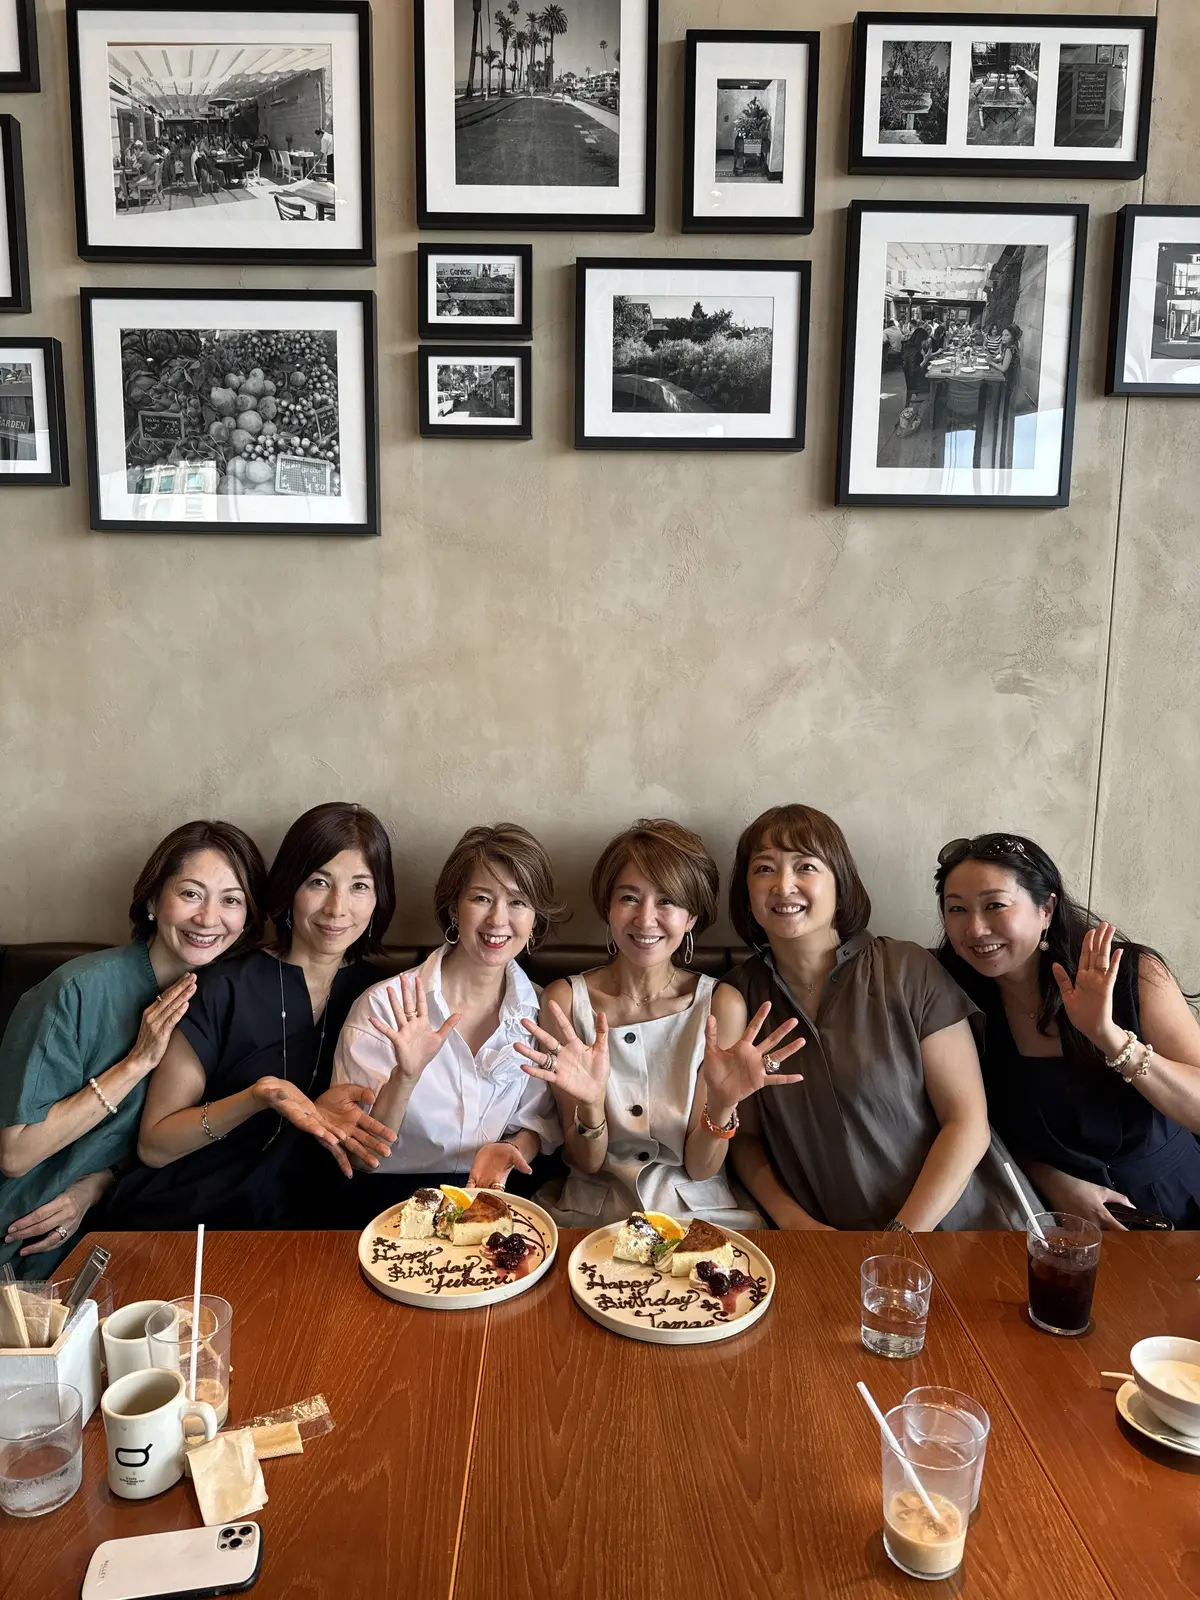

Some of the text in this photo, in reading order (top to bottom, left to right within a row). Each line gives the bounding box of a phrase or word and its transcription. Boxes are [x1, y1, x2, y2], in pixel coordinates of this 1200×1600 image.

[0, 419, 26, 430] ARDEN
[371, 1247, 443, 1264] Happy
[388, 1255, 482, 1282] Birthday
[425, 1273, 513, 1294] Yukari
[587, 1272, 662, 1294] Happy
[595, 1290, 700, 1311] Birthday
